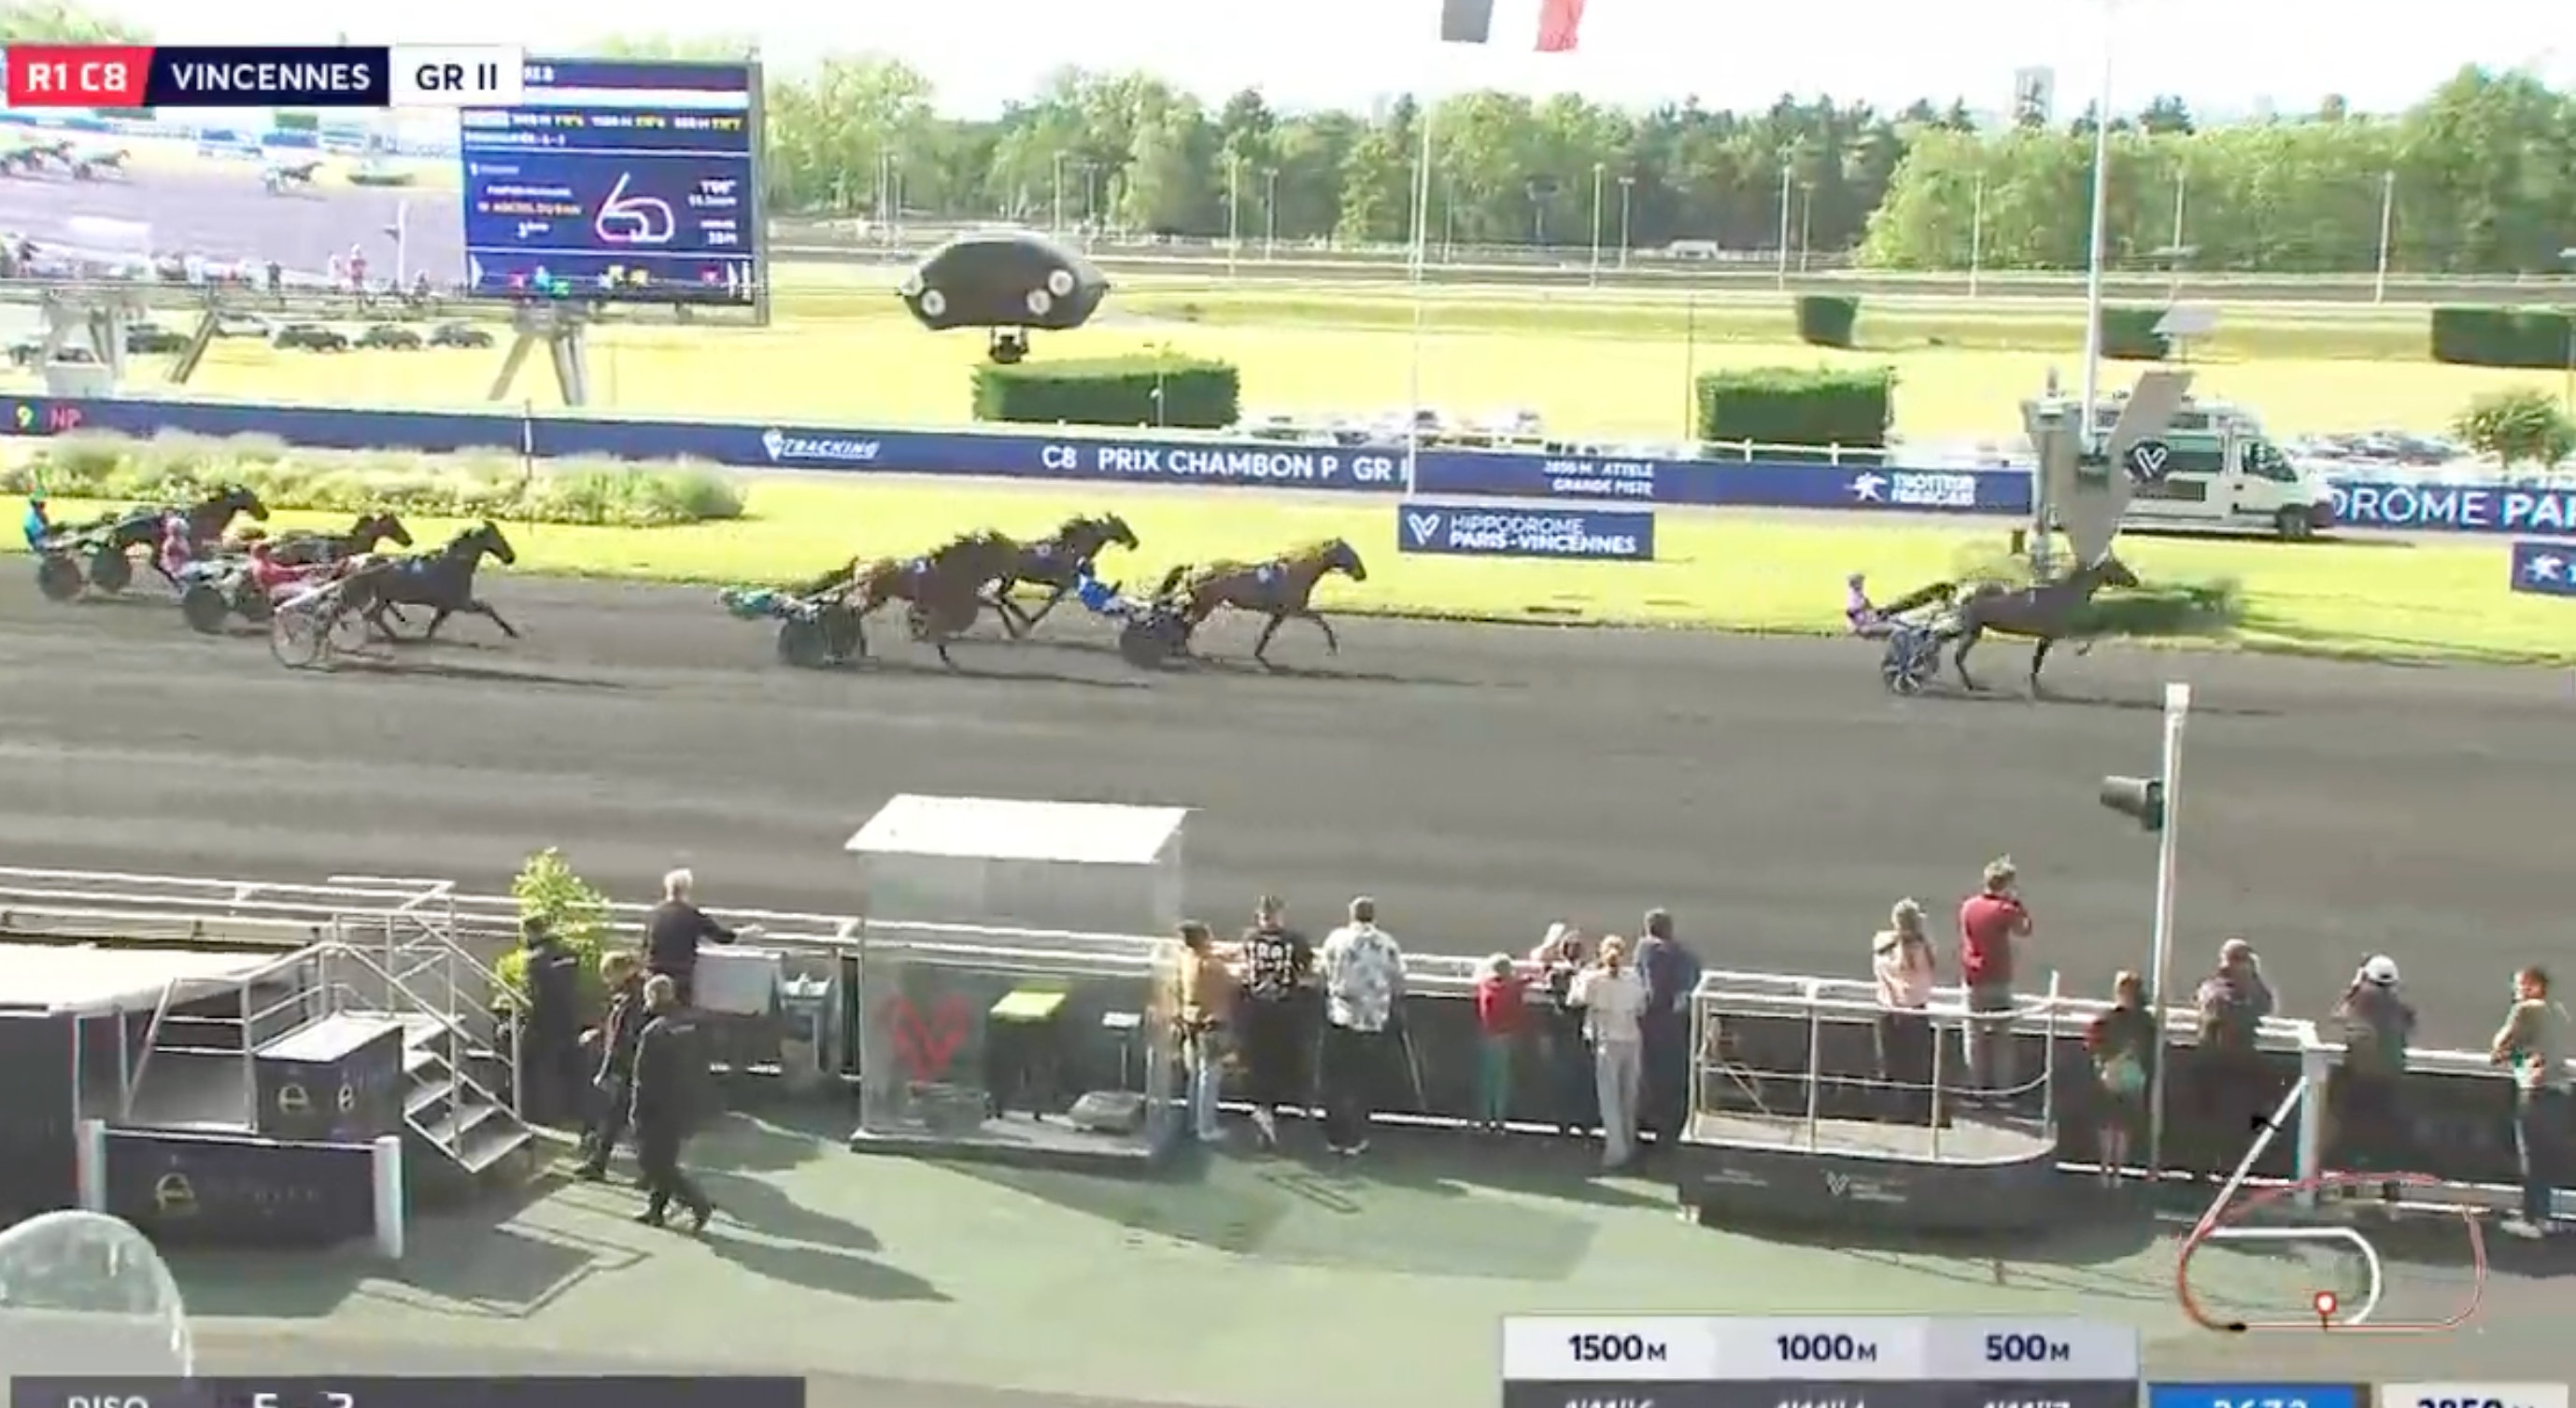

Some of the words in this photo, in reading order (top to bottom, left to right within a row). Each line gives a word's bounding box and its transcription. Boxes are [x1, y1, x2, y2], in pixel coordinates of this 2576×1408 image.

[1041, 445, 1078, 470] C8
[1098, 446, 1161, 472] PRIX
[1168, 449, 1313, 479] CHAMBON
[1322, 455, 1338, 479] P
[1352, 456, 1393, 481] GR
[1451, 514, 1585, 536] HIPPODROME
